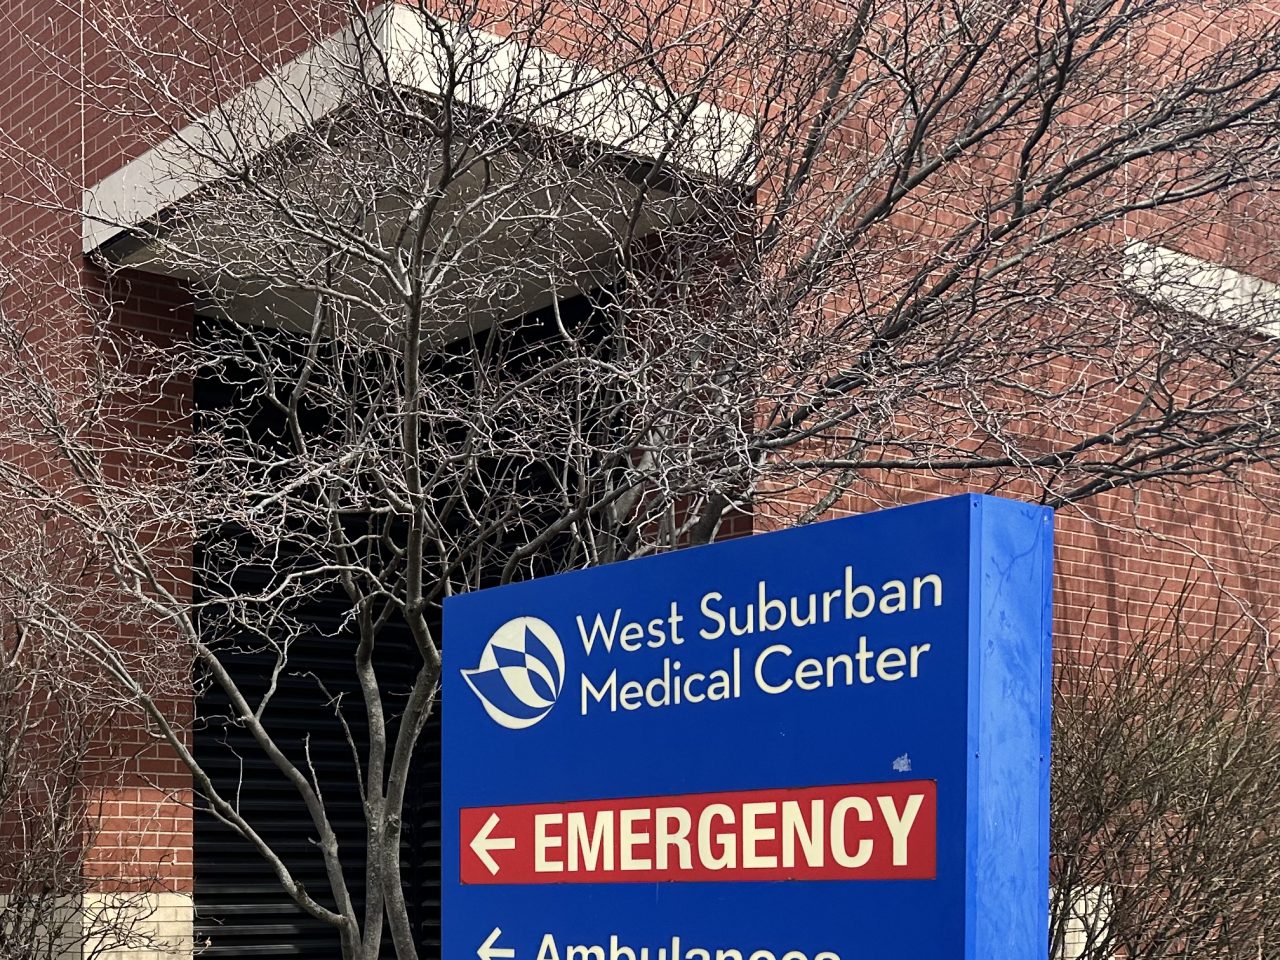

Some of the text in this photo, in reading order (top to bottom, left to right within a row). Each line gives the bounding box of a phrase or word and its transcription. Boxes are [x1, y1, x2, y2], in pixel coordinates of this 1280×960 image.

[575, 565, 943, 656] West Suburban
[580, 636, 931, 716] Medical Center
[534, 794, 925, 873] EMERGENCY
